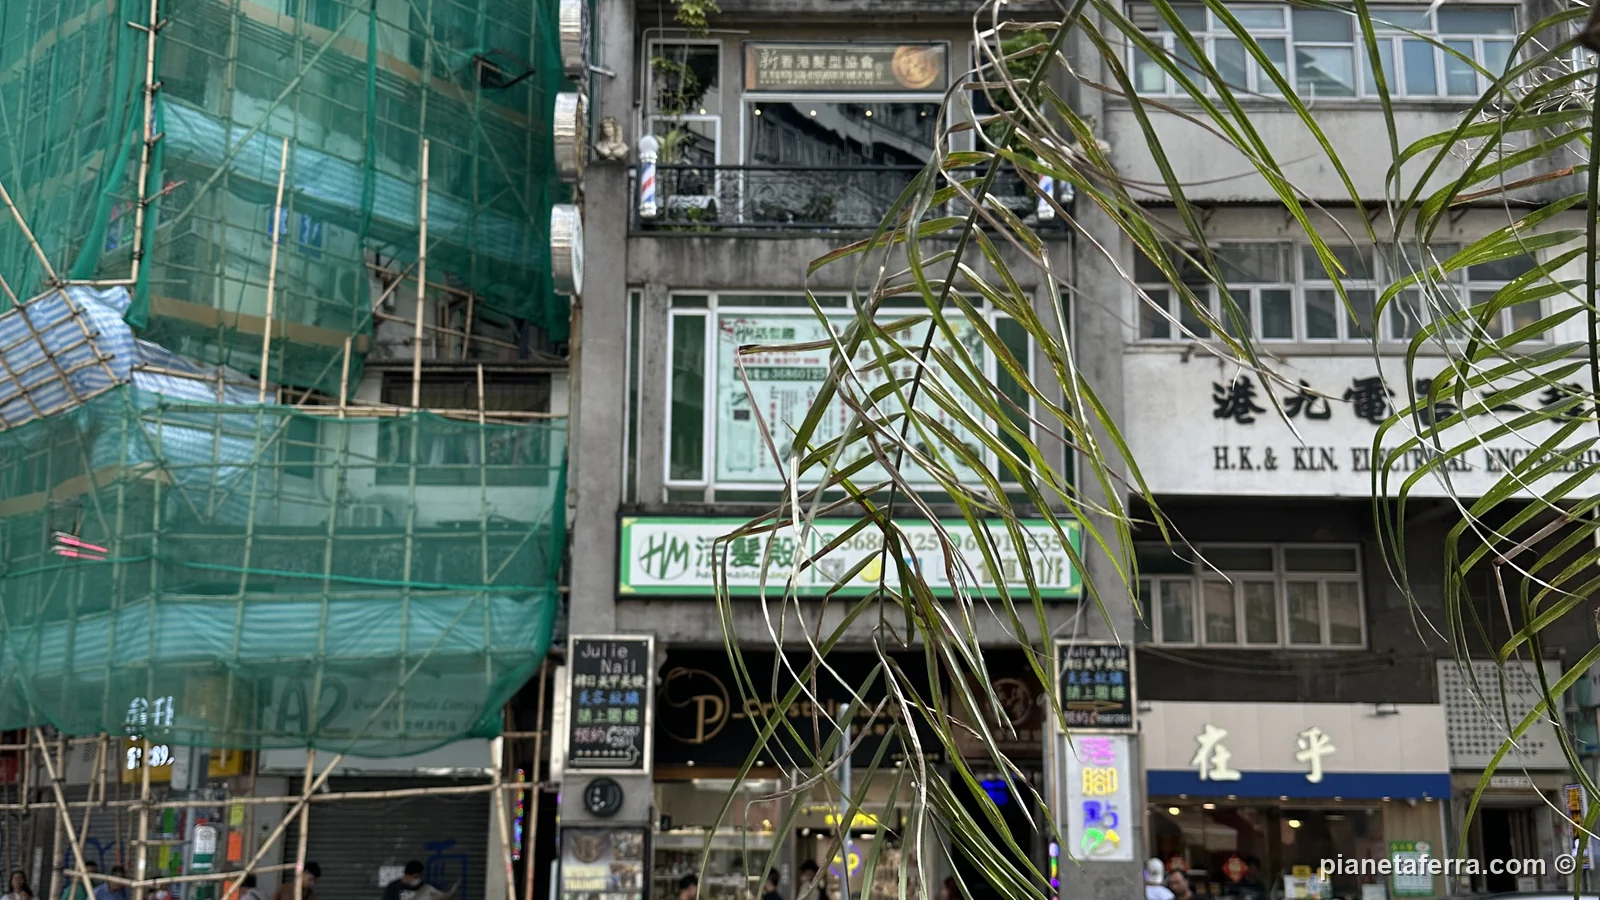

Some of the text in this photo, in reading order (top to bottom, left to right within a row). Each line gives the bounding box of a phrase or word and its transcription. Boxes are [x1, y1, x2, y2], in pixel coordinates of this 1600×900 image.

[1292, 446, 1338, 470] KLN.
[639, 531, 690, 580] HM
[581, 642, 628, 659] Julie
[1100, 646, 1127, 659] Nail
[600, 658, 637, 674] Nail
[1190, 722, 1337, 784] 在乎
